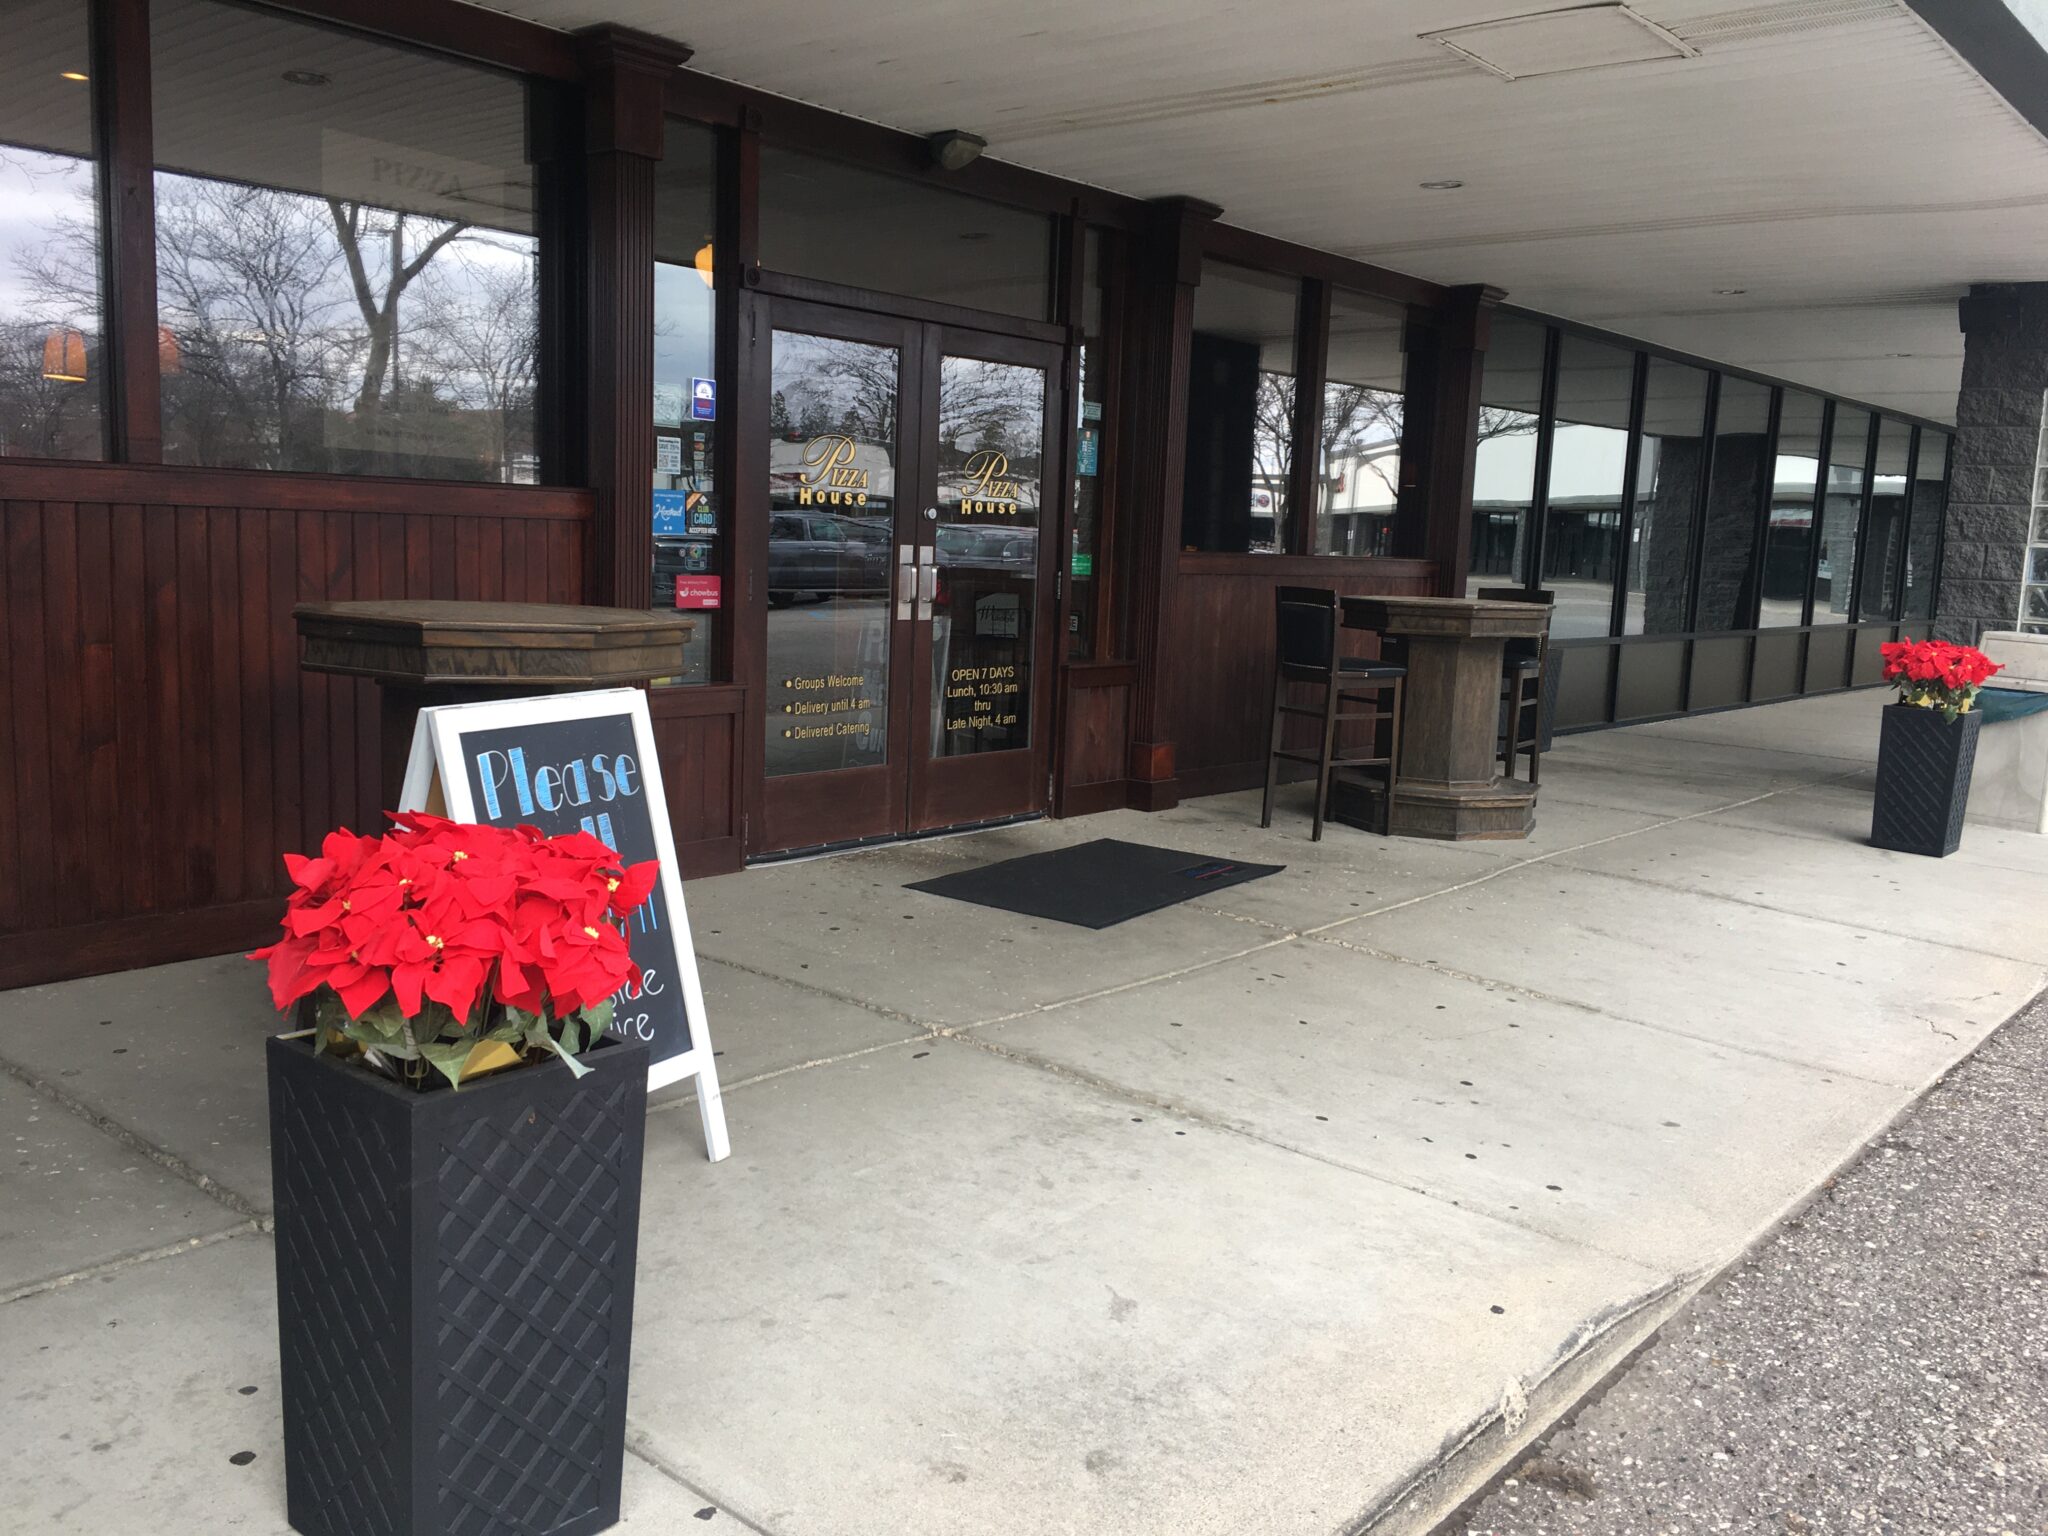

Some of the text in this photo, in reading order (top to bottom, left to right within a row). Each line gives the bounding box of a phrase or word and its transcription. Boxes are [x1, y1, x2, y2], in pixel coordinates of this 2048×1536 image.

[694, 513, 713, 525] CARD
[690, 588, 719, 597] chowbus
[951, 665, 1014, 681] OPEN 7 DAYS
[794, 675, 864, 691] Groups Welcome
[947, 682, 1018, 698] Lunch, 10:30 am
[794, 698, 871, 715] Delivery until 4 am
[974, 700, 991, 711] thru
[946, 713, 1017, 730] Late Night, 4 am
[794, 722, 870, 739] Delivered Catering
[476, 746, 640, 820] Please
